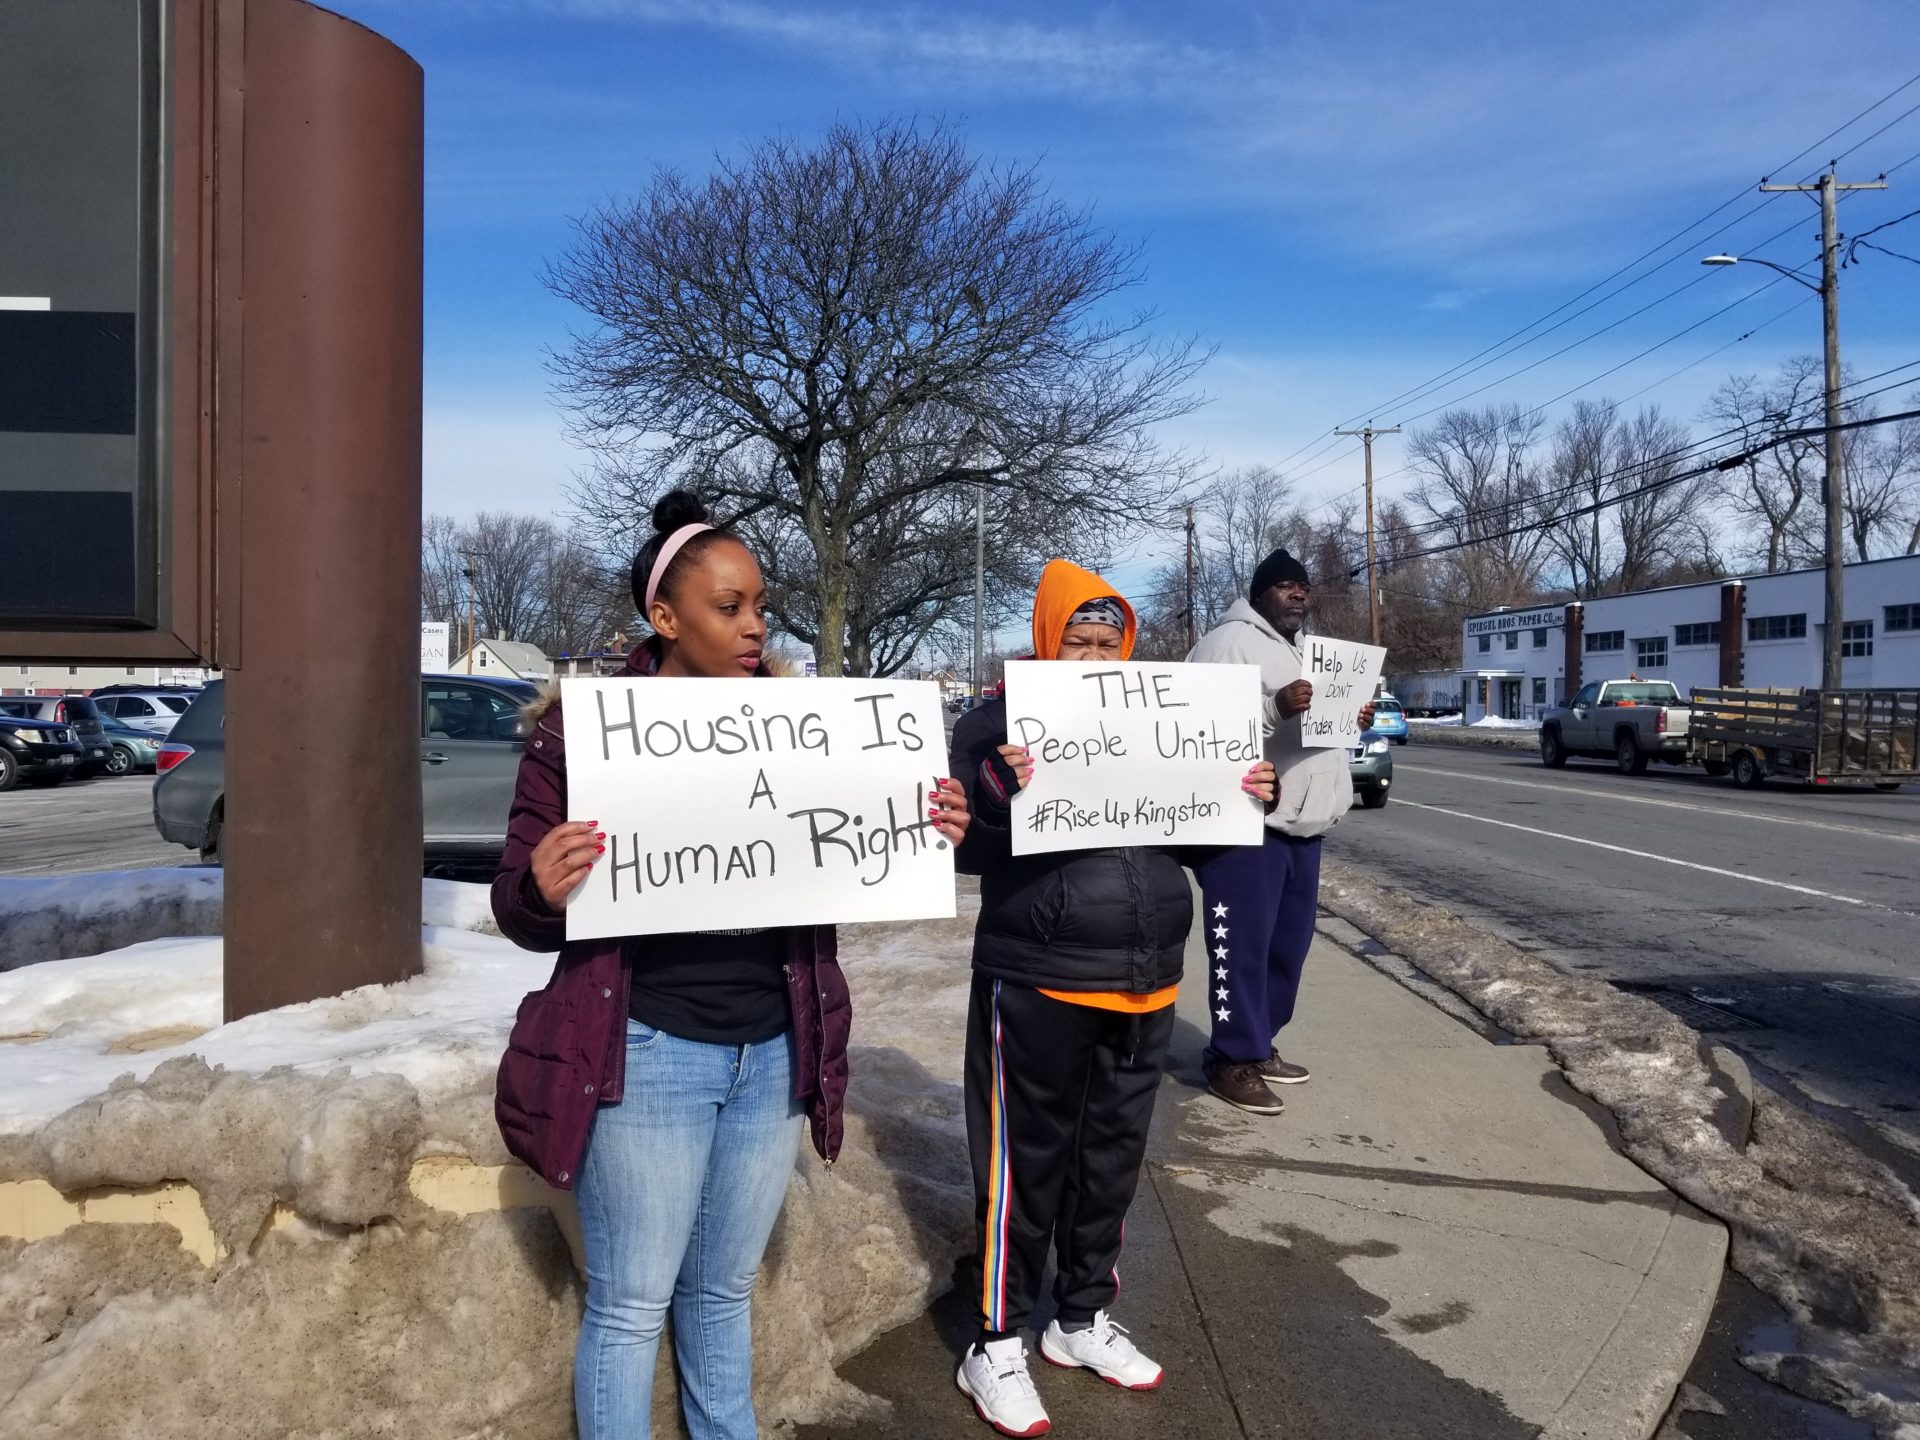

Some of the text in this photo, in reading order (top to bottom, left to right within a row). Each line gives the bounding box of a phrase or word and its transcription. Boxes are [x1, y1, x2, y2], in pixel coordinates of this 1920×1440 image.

[1469, 619, 1496, 633] SPIEGEL
[1518, 613, 1541, 627] PAPER
[1312, 643, 1367, 680] Help Us
[1082, 671, 1189, 708] THE
[855, 693, 923, 752] Is
[1014, 717, 1260, 767] People United!
[1340, 712, 1357, 736] Us.
[749, 768, 777, 809] A
[787, 775, 948, 887] Right!
